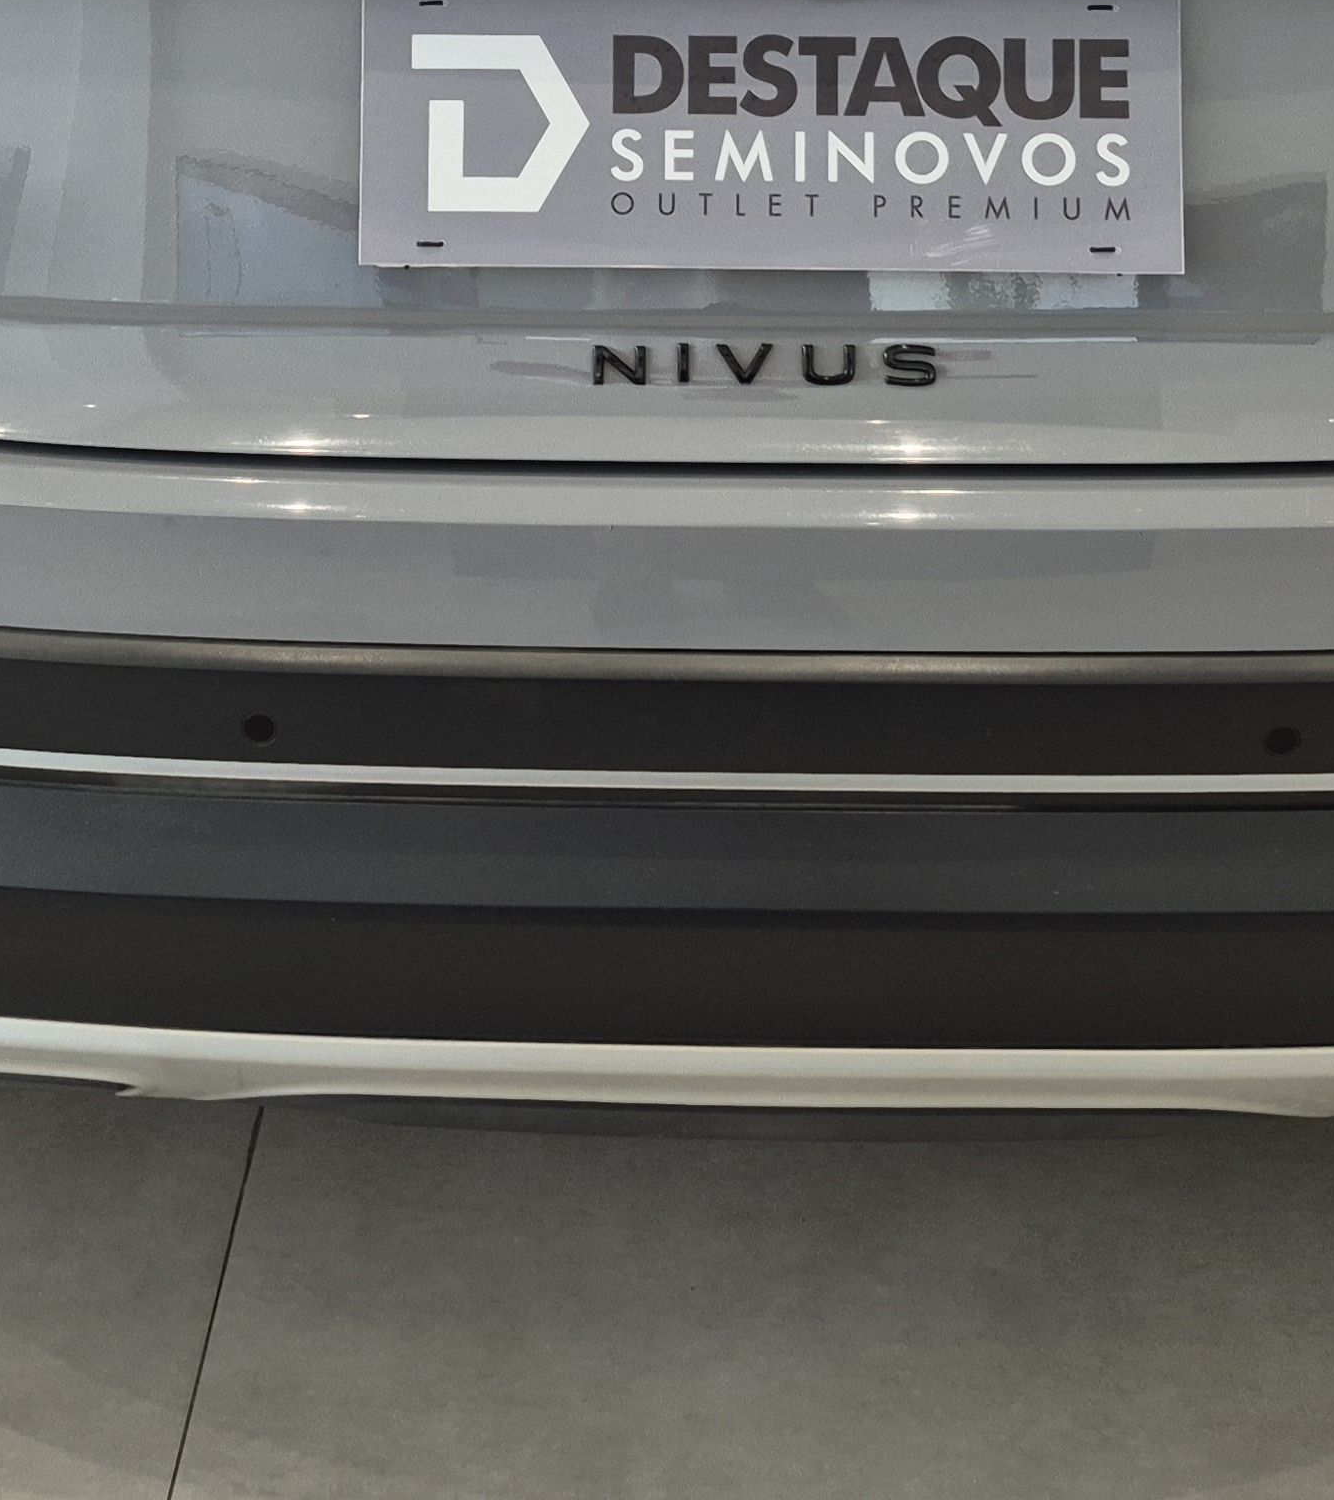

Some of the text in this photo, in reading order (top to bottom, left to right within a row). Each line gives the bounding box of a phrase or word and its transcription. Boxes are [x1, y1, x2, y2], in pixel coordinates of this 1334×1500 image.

[610, 33, 1131, 127] DESTAQUE
[610, 127, 1132, 188] SEMINOVOS
[610, 191, 1132, 222] OUTLET PREMIUM
[591, 342, 937, 387] NIVUS
